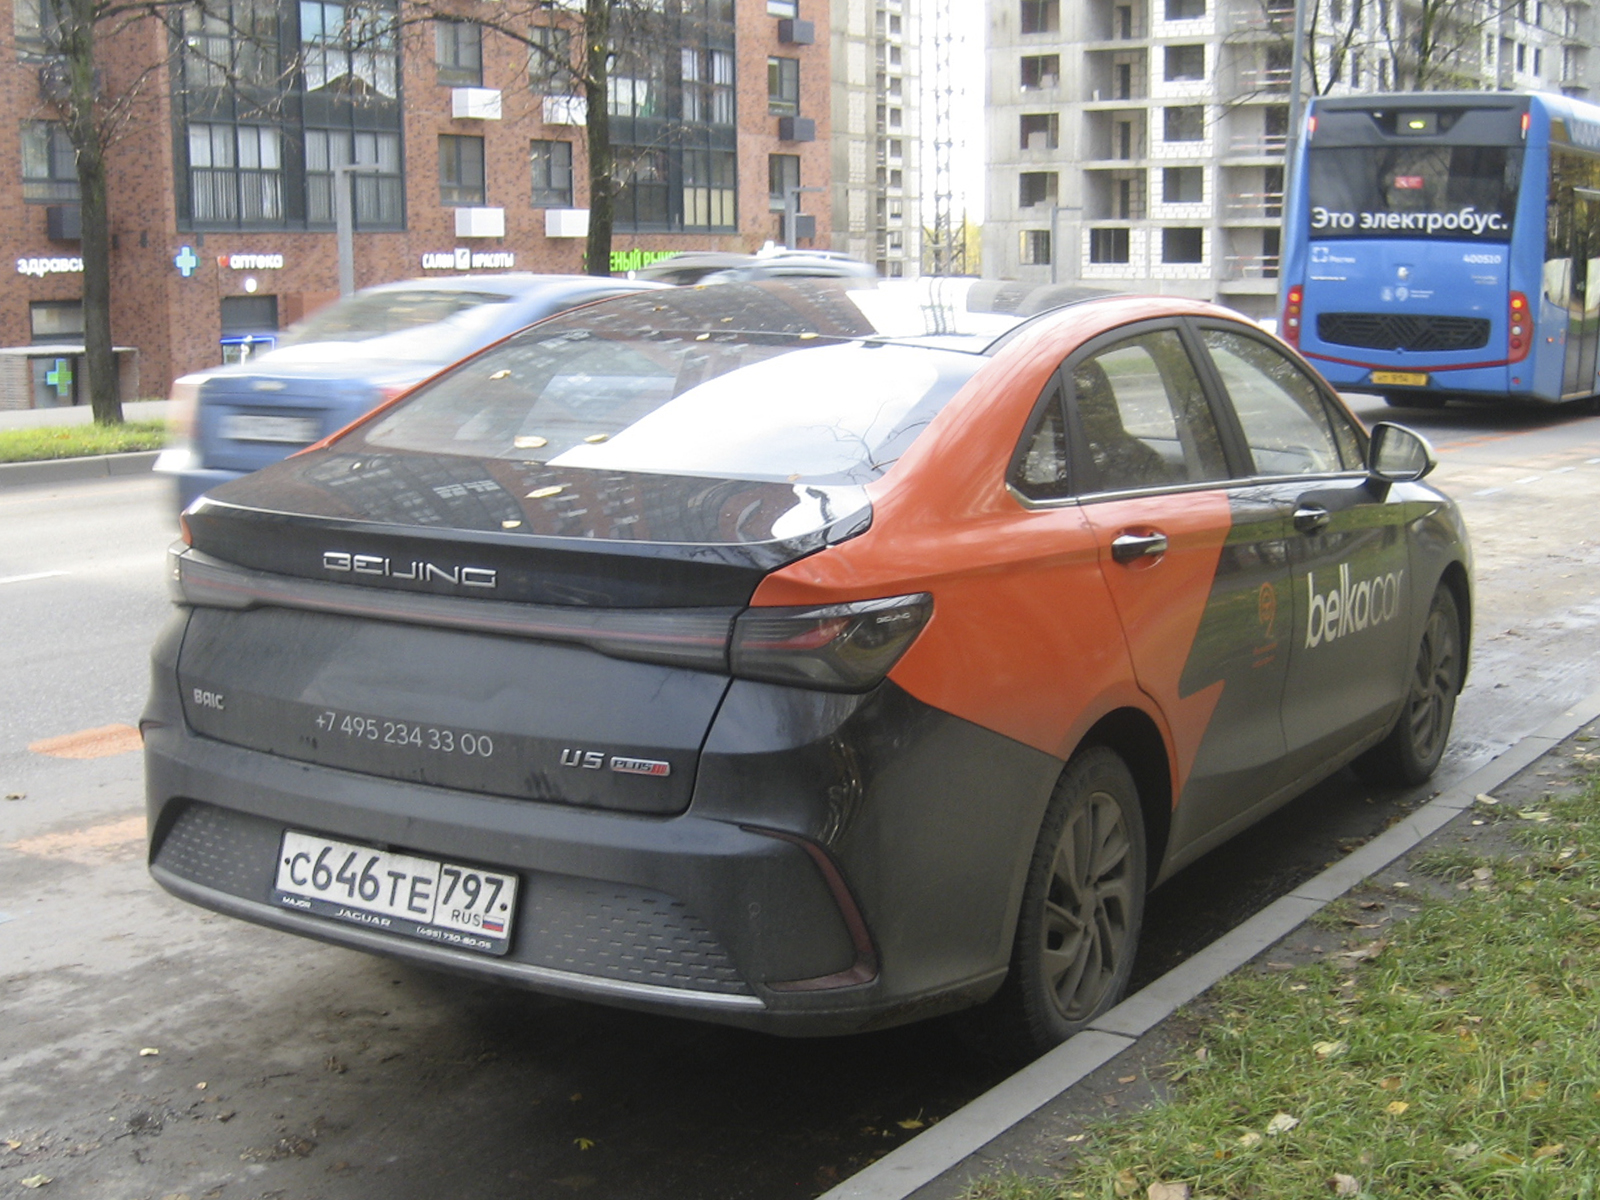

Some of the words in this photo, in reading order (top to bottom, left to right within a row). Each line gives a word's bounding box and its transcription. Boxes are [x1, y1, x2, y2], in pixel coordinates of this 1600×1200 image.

[1311, 206, 1355, 229] Это
[1360, 206, 1509, 235] электробус.
[230, 255, 284, 269] аптека
[323, 551, 497, 588] BEIJING
[1304, 562, 1404, 650] belkacar
[315, 711, 337, 733] +7
[340, 716, 379, 741] 495
[383, 721, 423, 749] 234
[428, 727, 455, 753] 33
[460, 732, 494, 758] 00
[282, 896, 312, 909] MAJOR
[442, 867, 505, 915] 797
[335, 908, 392, 927] JAGUAR
[451, 908, 481, 928] RUS
